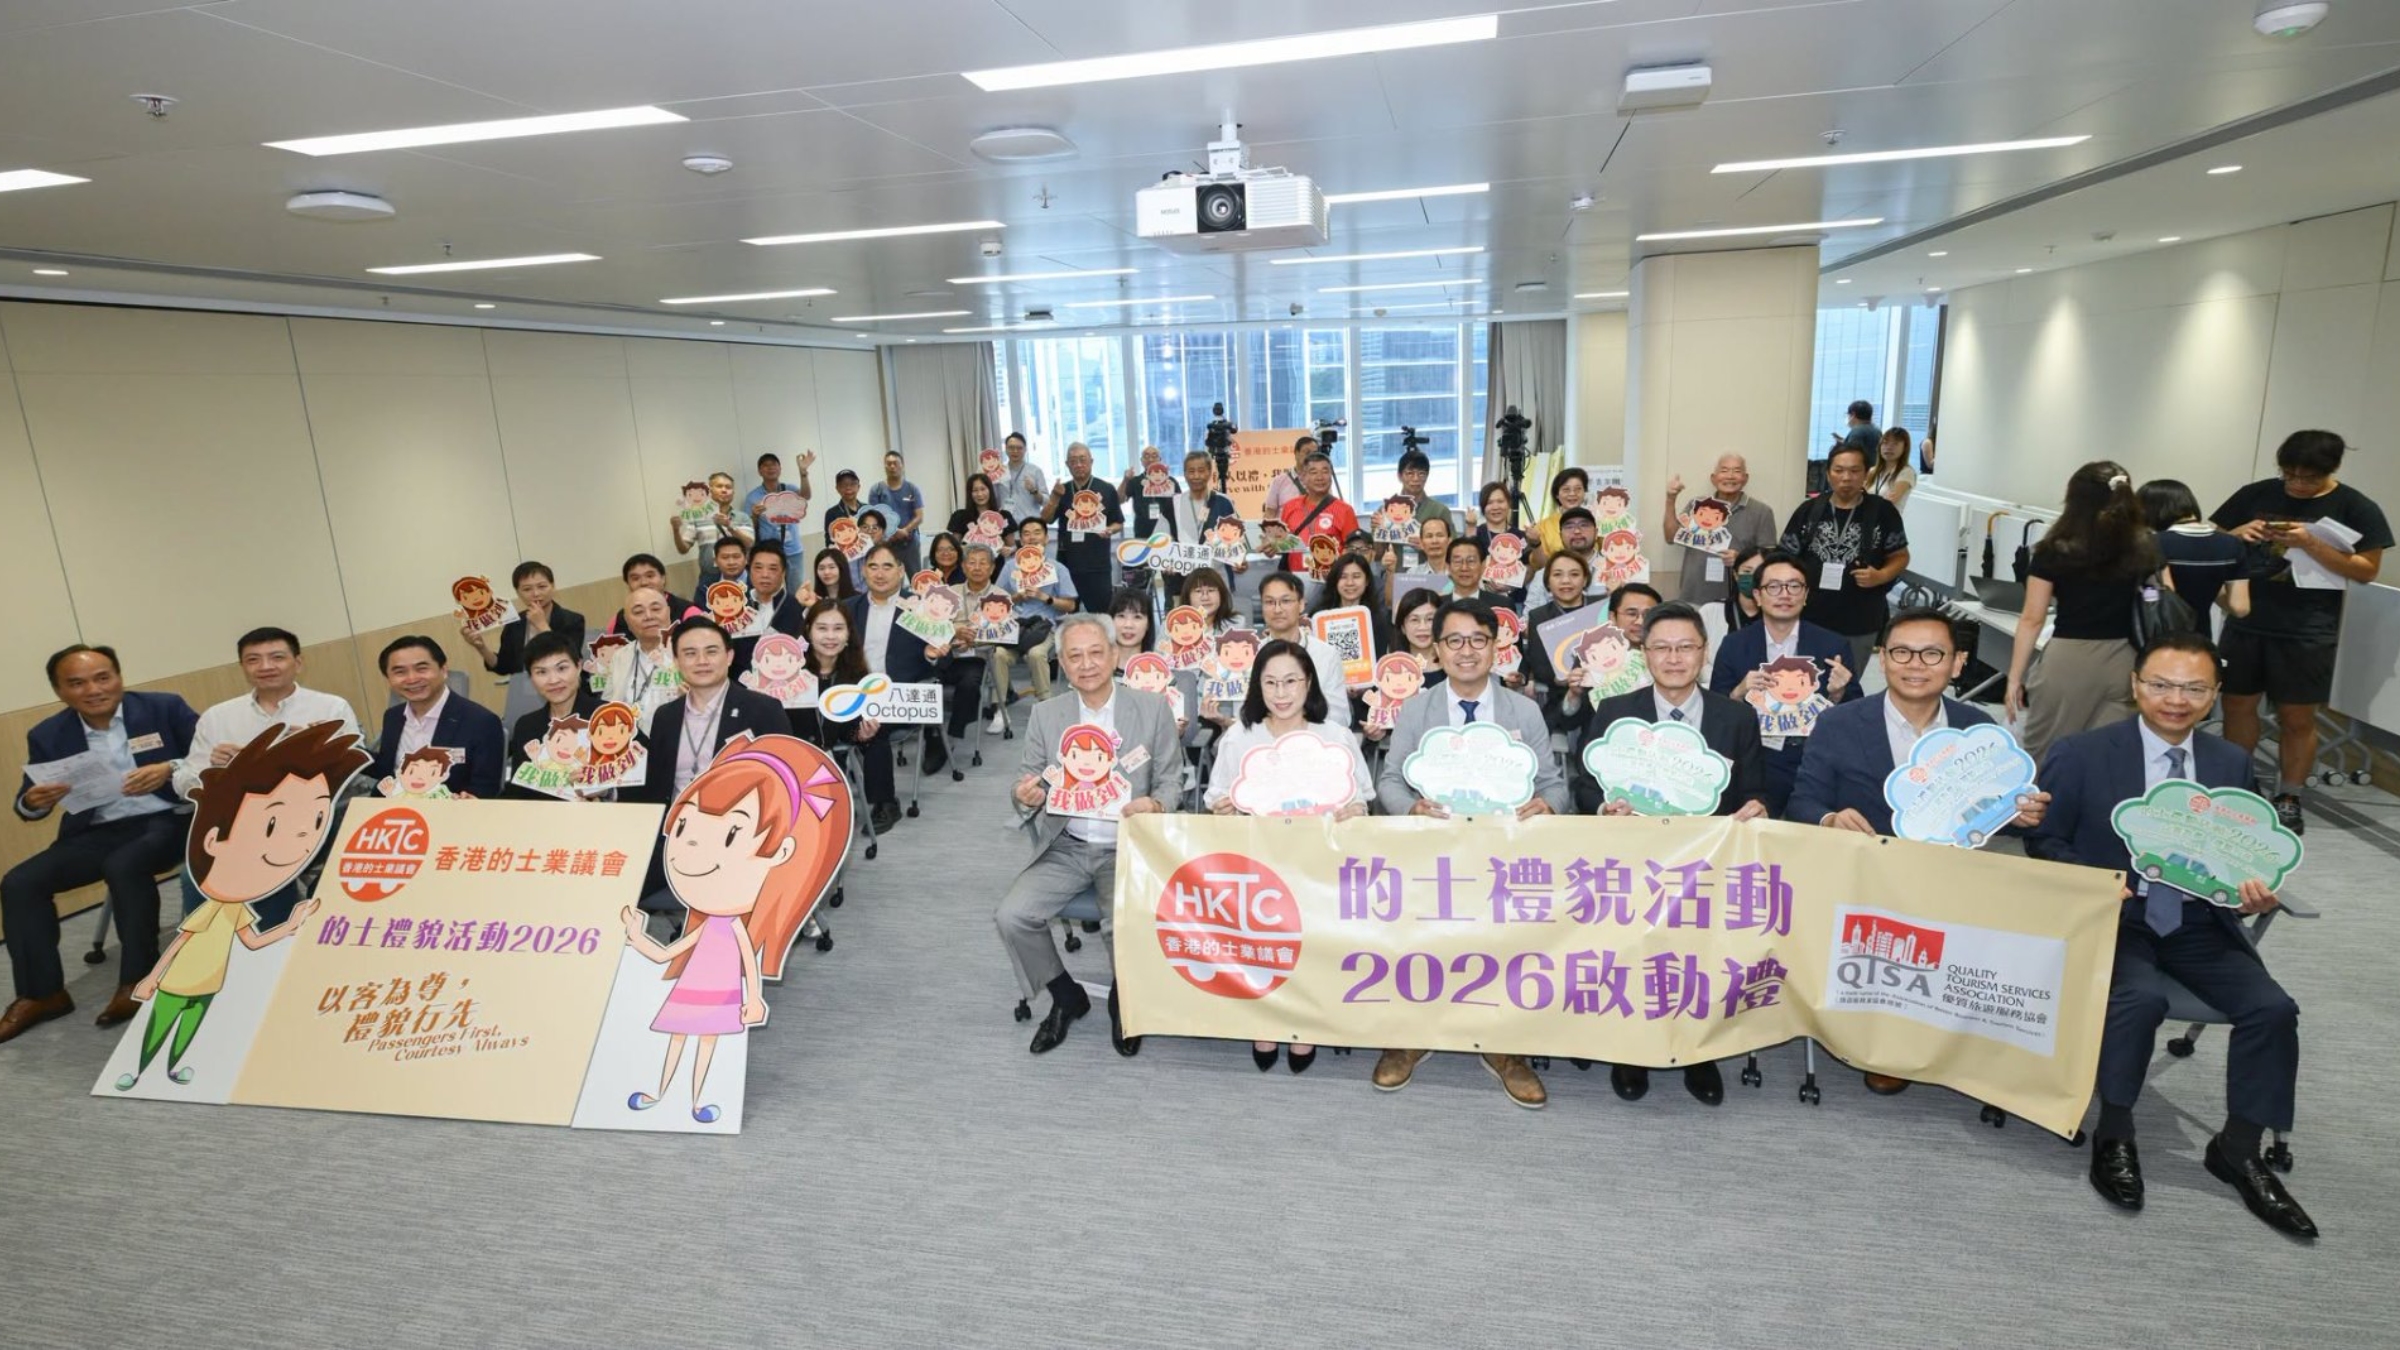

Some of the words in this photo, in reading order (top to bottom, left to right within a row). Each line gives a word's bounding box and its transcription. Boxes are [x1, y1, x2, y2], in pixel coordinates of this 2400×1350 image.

[1169, 543, 1209, 560] 八達通
[1676, 529, 1730, 546] 我做到!
[888, 687, 939, 703] 八達通
[866, 702, 939, 721] Octopus
[1050, 775, 1127, 812] 我做到!
[355, 818, 424, 857] HKTC
[342, 860, 418, 876] 香港的士業議會
[435, 845, 628, 877] 香港的士業議會
[1174, 872, 1283, 932] HKTC
[1339, 856, 1794, 937] 的士禮貌活動
[317, 914, 601, 956] 的士禮貌活動2026
[1165, 936, 1295, 964] 香港的士業議會
[1340, 949, 1789, 1021] 2026啟動禮
[1837, 957, 1932, 998] QTSA
[1947, 964, 1998, 980] QUALITY
[1944, 983, 2025, 1007] ASSOCIATION
[1946, 973, 1998, 992] TOURISM
[2001, 984, 2051, 1000] SERVICES
[343, 998, 480, 1043] 禮貌行先
[1942, 993, 2048, 1025] 優質旅遊服務協會
[367, 1031, 456, 1052] Passengers
[394, 1043, 462, 1062] Courtesy
